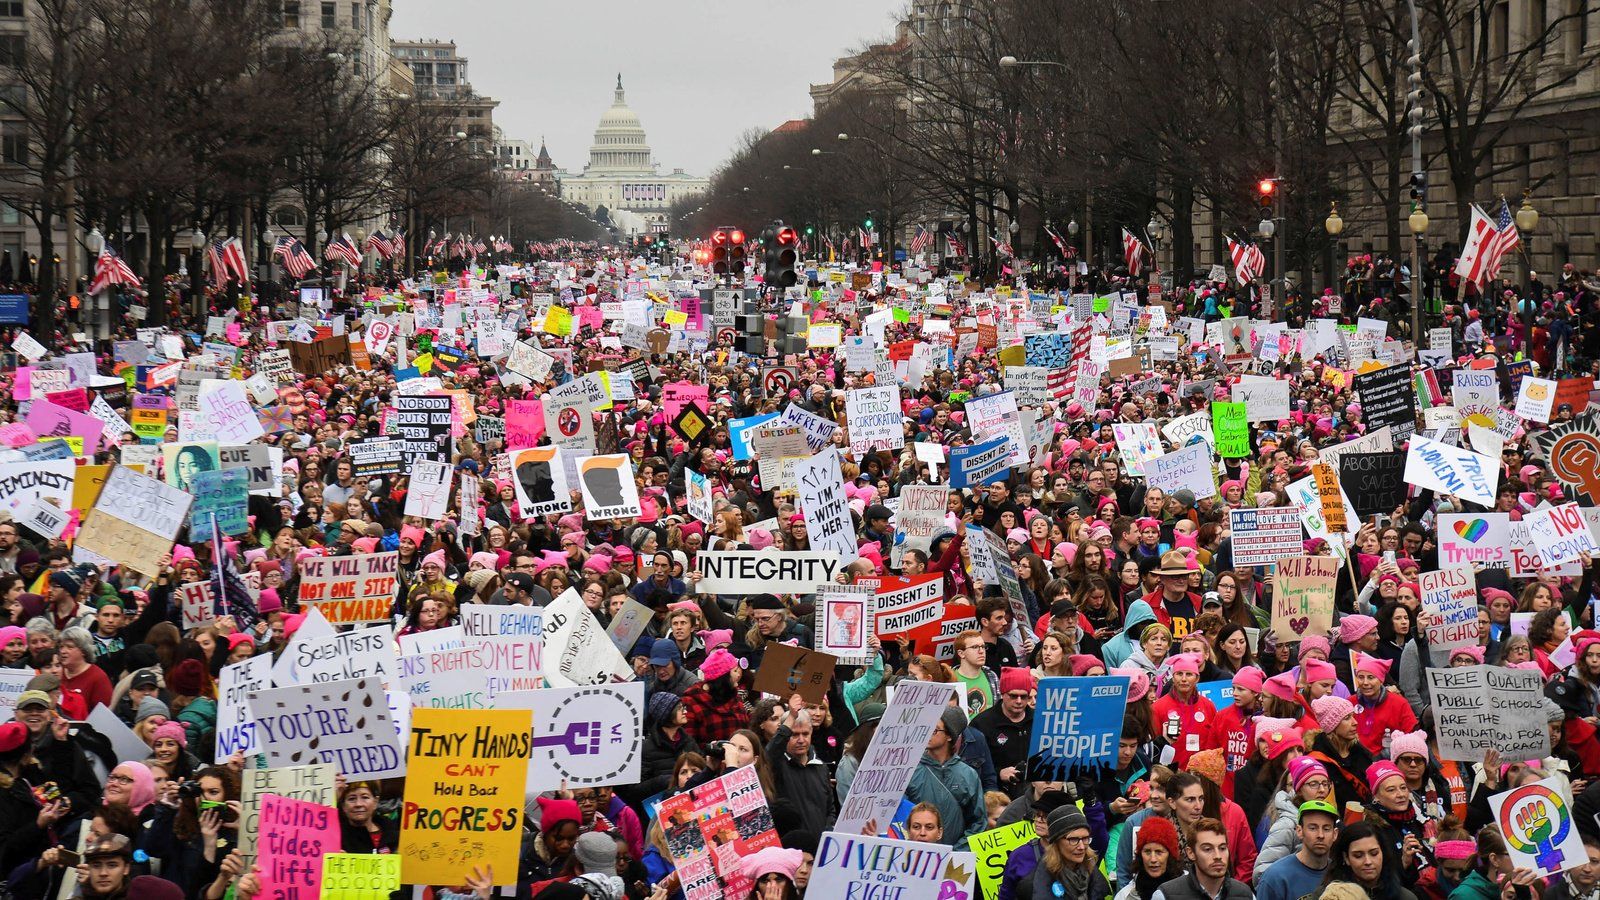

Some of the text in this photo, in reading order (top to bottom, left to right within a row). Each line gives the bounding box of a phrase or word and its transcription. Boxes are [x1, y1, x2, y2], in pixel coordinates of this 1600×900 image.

[876, 362, 891, 372] NOT
[876, 372, 895, 381] THIS
[1015, 370, 1046, 380] not free
[1081, 361, 1097, 376] PRO
[557, 378, 593, 397] THIS IS
[1456, 374, 1492, 387] RAISED
[207, 387, 230, 409] HE
[399, 399, 449, 409] NOBODY
[1079, 388, 1095, 402] PRO
[208, 400, 251, 432] STARTED
[856, 400, 888, 414] UTERUS
[1458, 404, 1493, 419] RISE UP
[399, 413, 450, 423] PUTS MY
[788, 409, 836, 437] WE'RE NOT
[1171, 416, 1209, 440] RESPECT
[227, 420, 250, 440] IT
[760, 430, 776, 438] LOVE
[967, 445, 1005, 468] DISSENT IS
[1156, 450, 1198, 473] RESPECT
[417, 463, 438, 475] FUCK
[419, 474, 436, 484] OFF
[971, 459, 1005, 481] PATRIOTIC
[1149, 464, 1198, 487] EXISTENCE
[1457, 455, 1493, 497] TRUST
[0, 471, 74, 499] FEMINIST
[1359, 473, 1397, 491] SAVES
[817, 486, 834, 505] I'M
[1357, 491, 1396, 511] LIVES
[524, 502, 569, 516] WRONG
[591, 505, 638, 517] WRONG
[814, 499, 842, 523] WITH
[1232, 512, 1256, 522] IN OUR
[1258, 513, 1300, 524] LOVE WINS
[35, 511, 61, 529] ALLY
[822, 517, 843, 538] HER
[1233, 522, 1257, 530] AMERICA
[1549, 504, 1586, 537] NOT
[1540, 535, 1600, 564] NORMAL
[305, 555, 397, 577] WE WILL TAKE
[699, 556, 837, 581] INTEGRITY
[1278, 557, 1338, 578] Well Behaved
[1485, 560, 1509, 569] HATE
[301, 577, 395, 599] NOT ONE STEP
[1422, 568, 1467, 591] GIRLS
[878, 588, 922, 609] DISSENT
[926, 583, 936, 597] IS
[1424, 590, 1476, 605] JUST WANNA
[1279, 598, 1298, 618] Make
[1439, 602, 1464, 612] HAVE
[461, 613, 543, 636] WELL BEHAVED
[885, 606, 936, 629] PATRIOTIC
[1429, 622, 1480, 645] RIGHTS
[298, 632, 384, 667] SCIENTISTS
[343, 658, 386, 680] NOT A
[431, 649, 483, 673] RIGHTS
[233, 662, 253, 684] THE
[1432, 671, 1540, 689] FREE QUALITY
[410, 681, 430, 694] ARE
[893, 684, 950, 706] THOU SHALT
[1093, 687, 1121, 696] ACLU
[1045, 688, 1079, 711] WE
[1437, 693, 1543, 709] PUBLIC SCHOOLS
[237, 706, 245, 722] IS
[257, 704, 353, 743] YOU'RE
[898, 707, 924, 725] NOT
[1041, 711, 1082, 735] THE
[1441, 714, 1500, 725] ARE THE
[411, 725, 529, 758] TINY HANDS
[610, 723, 622, 744] WE
[877, 725, 930, 745] MESS WITH
[1440, 726, 1544, 741] FOUNDATION FOR
[1038, 732, 1114, 758] PEOPLE
[1453, 739, 1543, 752] A DEMOCRACY
[319, 744, 398, 774] FIRED
[254, 767, 323, 789] BE THE
[445, 763, 500, 776] CAN'T
[852, 766, 913, 793] REPRODUCTIVE
[434, 782, 498, 796] Hold Back
[730, 782, 760, 799] ARE
[265, 799, 327, 830] rising
[403, 801, 518, 831] PROGRESS
[842, 796, 877, 821] RIGHTS
[704, 816, 732, 832] WOMEN
[268, 828, 322, 857] tides
[747, 833, 776, 849] WOMEN
[977, 832, 1006, 851] WE
[326, 857, 382, 876] THE FUTURE
[818, 836, 948, 880] DIVERSITY
[273, 858, 315, 886] lift
[686, 873, 717, 891] ARE
[860, 872, 896, 882] is our
[845, 881, 907, 900] RIGHT
